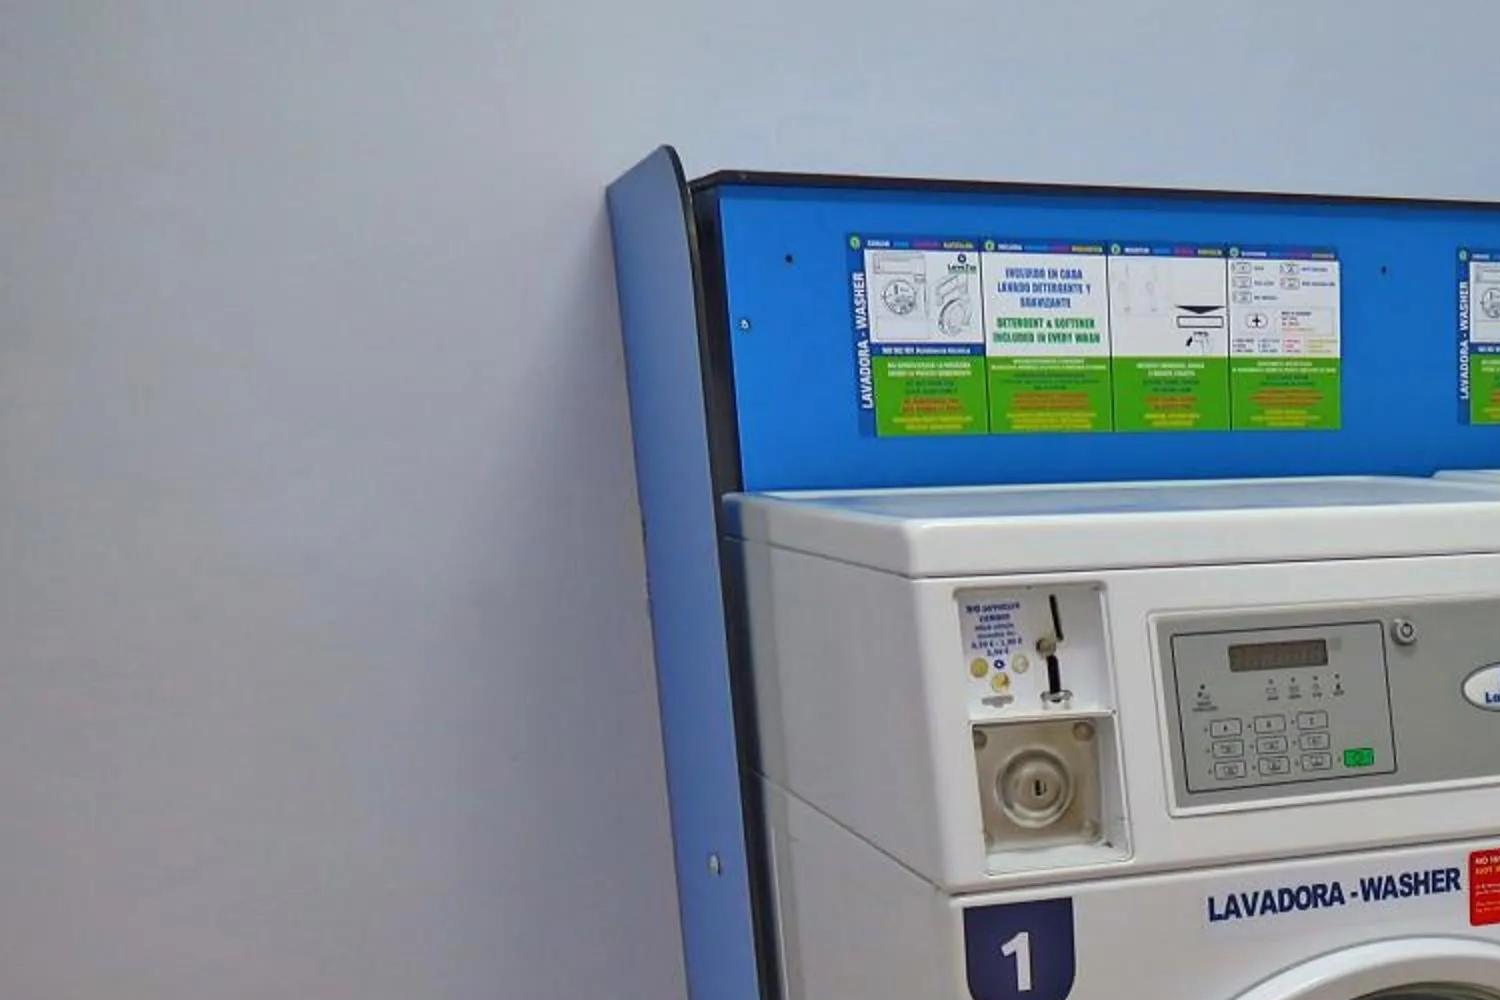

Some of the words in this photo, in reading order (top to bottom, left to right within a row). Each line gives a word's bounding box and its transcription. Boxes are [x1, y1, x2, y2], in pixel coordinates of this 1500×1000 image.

[852, 272, 867, 330] WASHER
[1459, 281, 1469, 331] WASHER
[857, 339, 874, 410] LAVADORA
[1459, 341, 1469, 400] LAVADORA
[1207, 881, 1345, 922] LAVADORA
[1359, 866, 1462, 903] WASHER
[1001, 931, 1032, 991] 1
